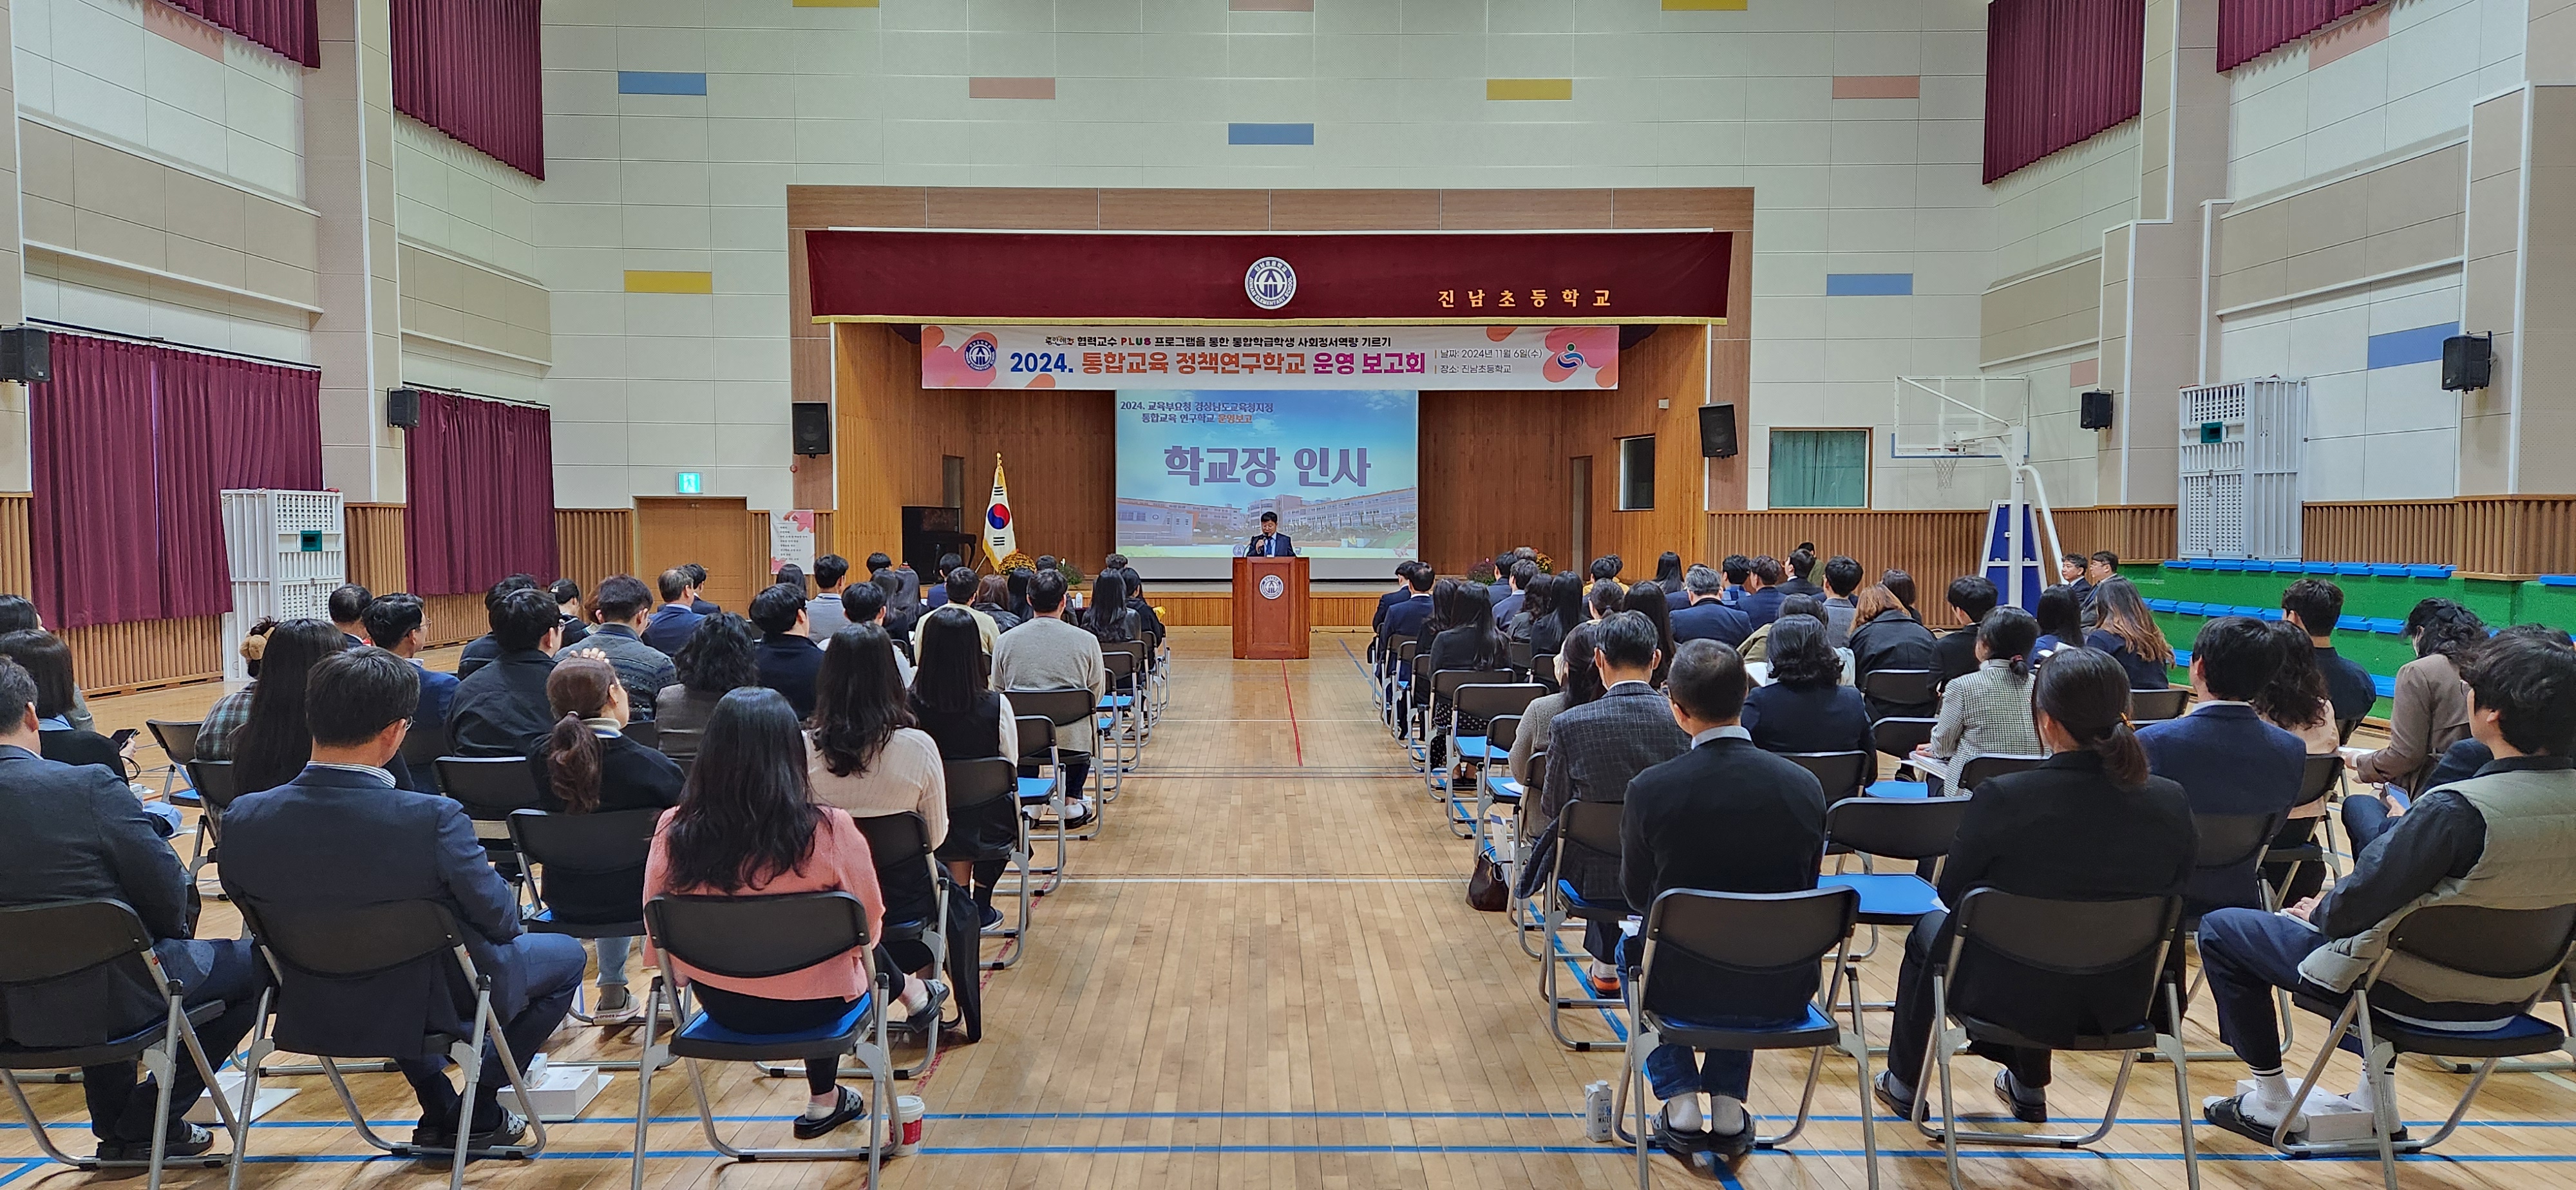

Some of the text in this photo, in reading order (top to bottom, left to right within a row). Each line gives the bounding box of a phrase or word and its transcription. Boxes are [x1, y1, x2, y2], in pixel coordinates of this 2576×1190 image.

[1255, 294, 1285, 305] ELEMENTARY
[1284, 276, 1293, 298] SCHOOL
[1437, 289, 1611, 308] 진남초등학교
[1077, 336, 1117, 346] 협력교수
[1121, 337, 1151, 346] PLUS
[1154, 337, 1206, 347] 프로그램을
[1208, 337, 1229, 347] 통한
[1232, 337, 1295, 347] 통합학급학생
[1298, 337, 1359, 347] 사회정서역량
[1362, 337, 1392, 347] 기르기
[1440, 348, 1542, 359] 날짜: 2024년 11월 6일(수)
[1010, 352, 1074, 373] 2024.
[1081, 352, 1169, 374] 통합교육
[1176, 352, 1306, 375] 정책연구학교
[1313, 352, 1354, 375] 운영
[1362, 352, 1425, 374] 보고회
[1440, 364, 1511, 374] 장소: 진남초등학교
[1121, 401, 1274, 413] 2024. 교육부요청 경상남도교육청지정
[1142, 413, 1253, 424] 통합교육 연구학교 운영보고
[1164, 446, 1372, 487] 학교장 인사
